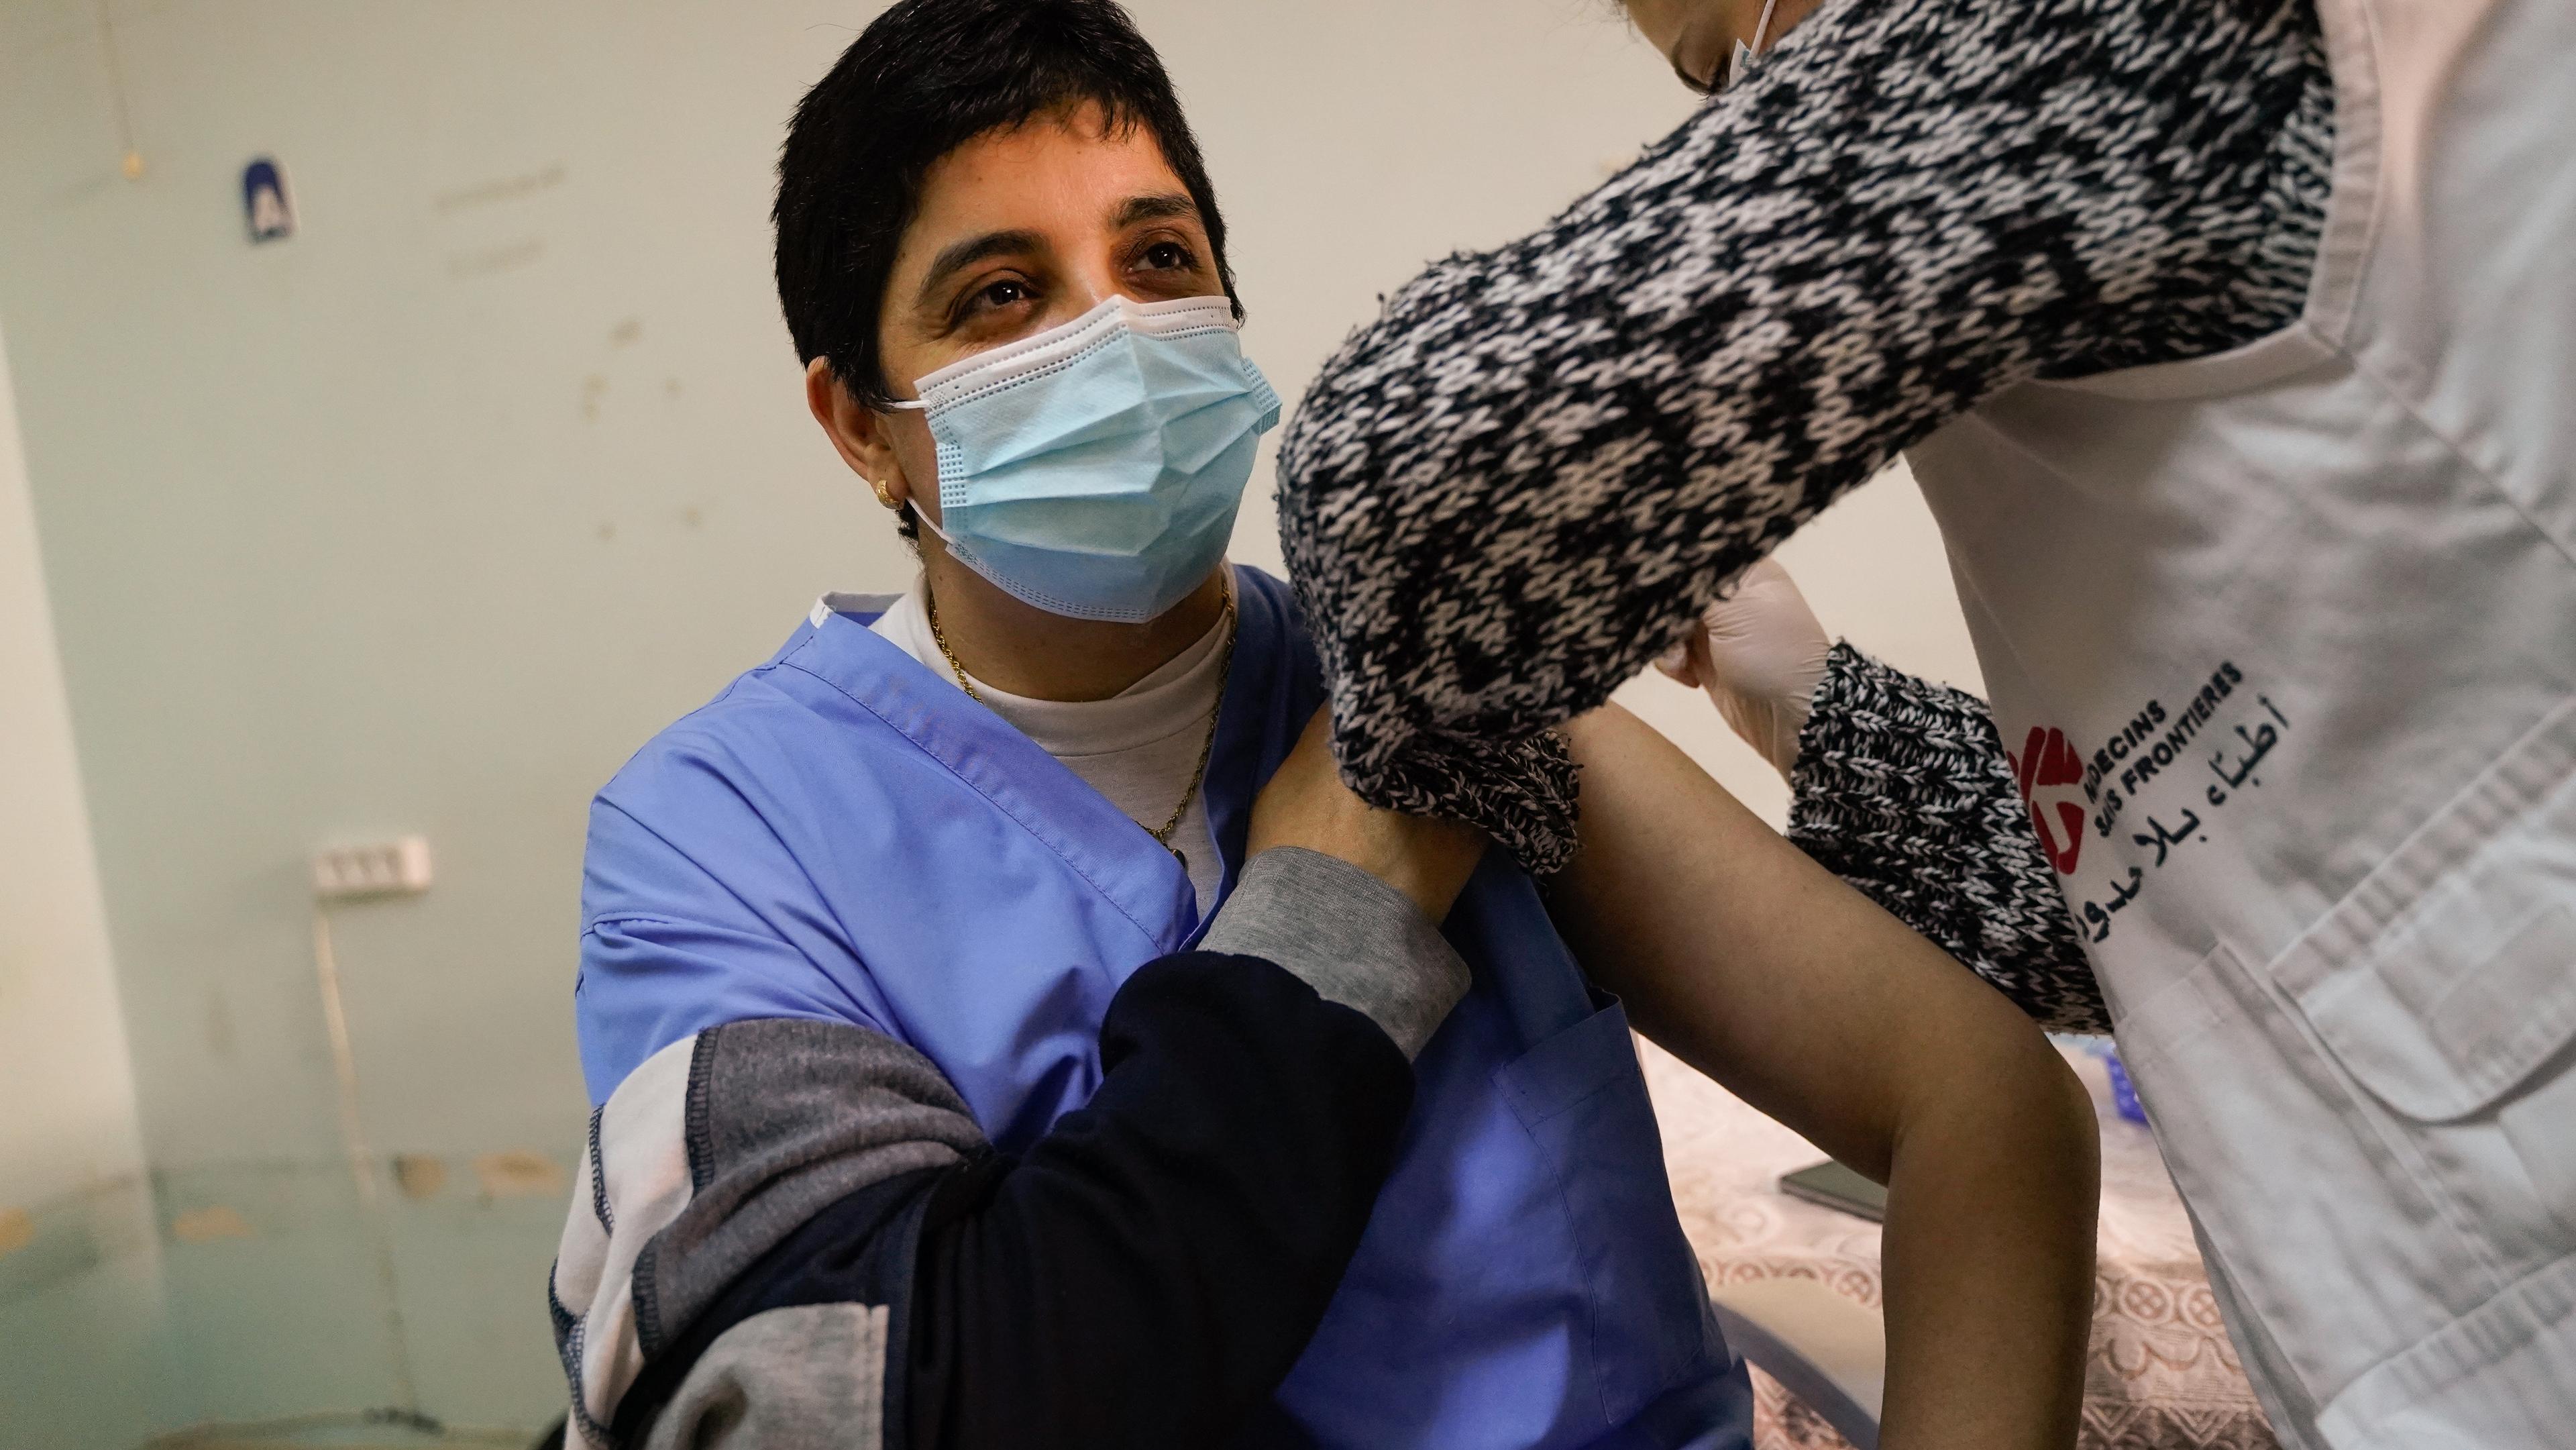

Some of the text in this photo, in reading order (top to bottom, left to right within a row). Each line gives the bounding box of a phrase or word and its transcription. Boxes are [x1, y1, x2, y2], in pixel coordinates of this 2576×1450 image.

[2084, 699, 2167, 805] MDECINS
[2094, 661, 2243, 838] SS FRONTIERES
[2132, 809, 2207, 868] بلا
